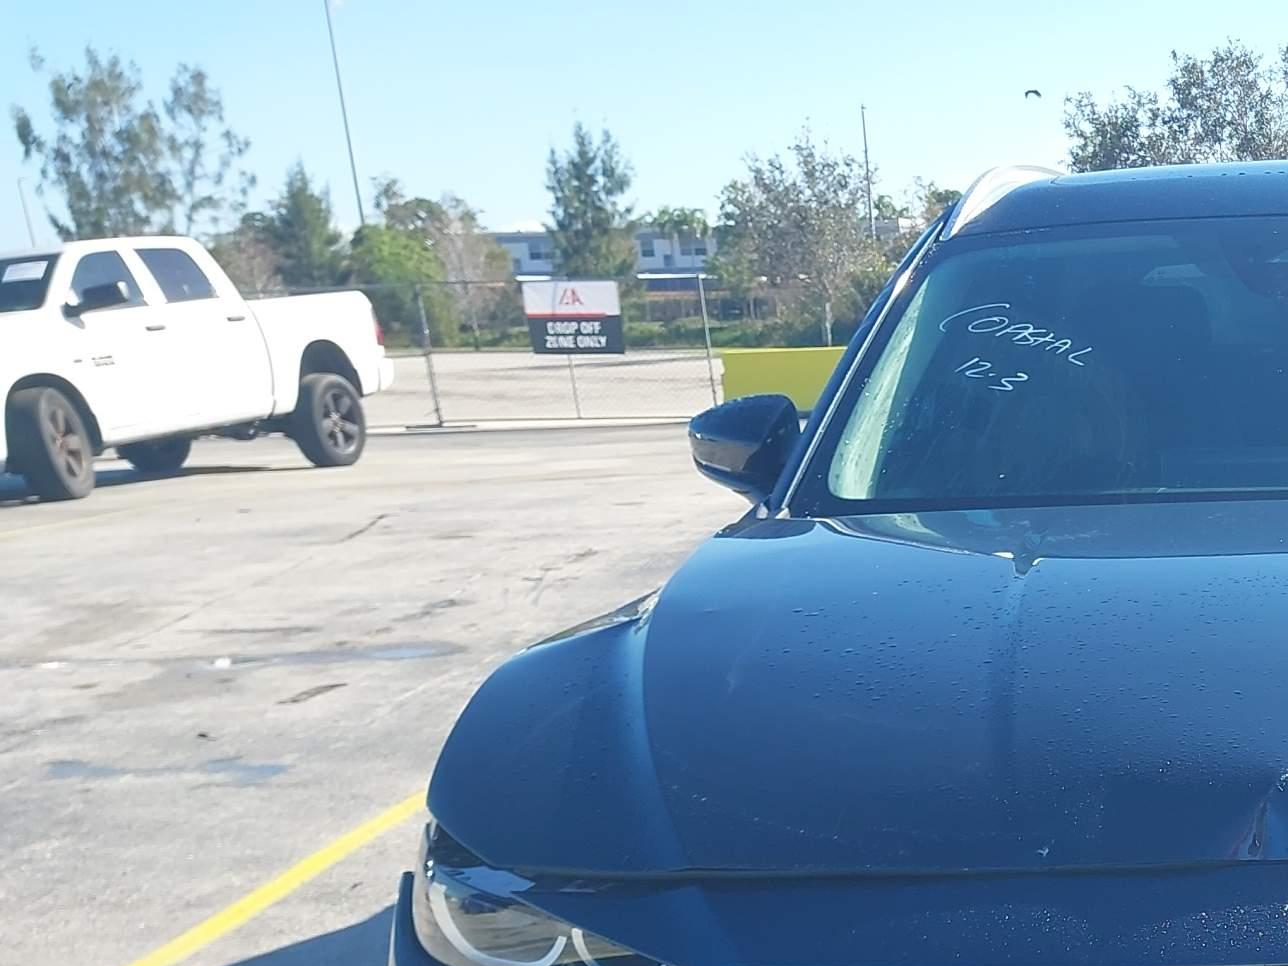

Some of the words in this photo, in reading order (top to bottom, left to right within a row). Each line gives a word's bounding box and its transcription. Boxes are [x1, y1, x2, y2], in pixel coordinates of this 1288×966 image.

[546, 321, 579, 335] DROP
[580, 321, 602, 335] OFF
[545, 335, 576, 349] ZONE
[576, 335, 607, 349] ONLY
